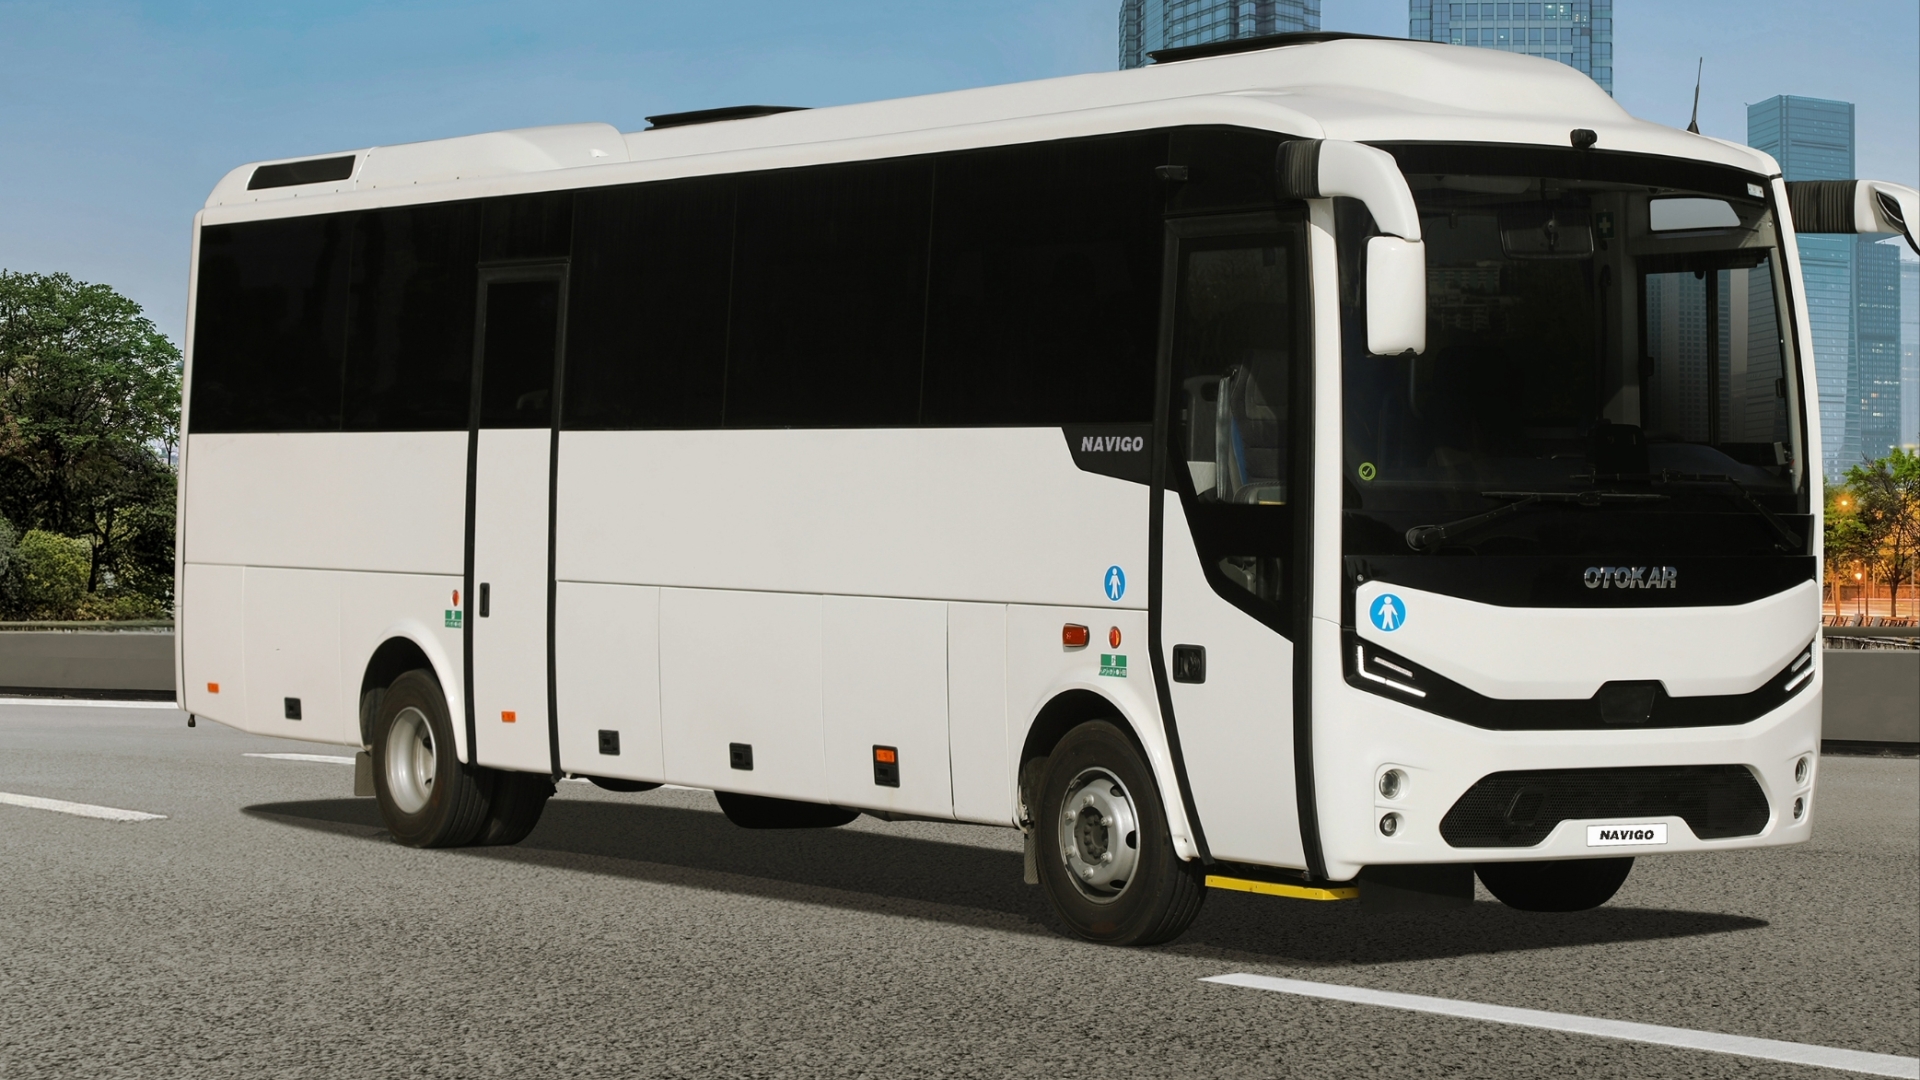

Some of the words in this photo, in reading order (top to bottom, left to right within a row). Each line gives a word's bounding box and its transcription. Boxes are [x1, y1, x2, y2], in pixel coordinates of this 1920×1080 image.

[1081, 436, 1144, 452] NAVIGO
[1584, 566, 1678, 589] OTOKAR
[1599, 830, 1654, 840] NAVIGO
